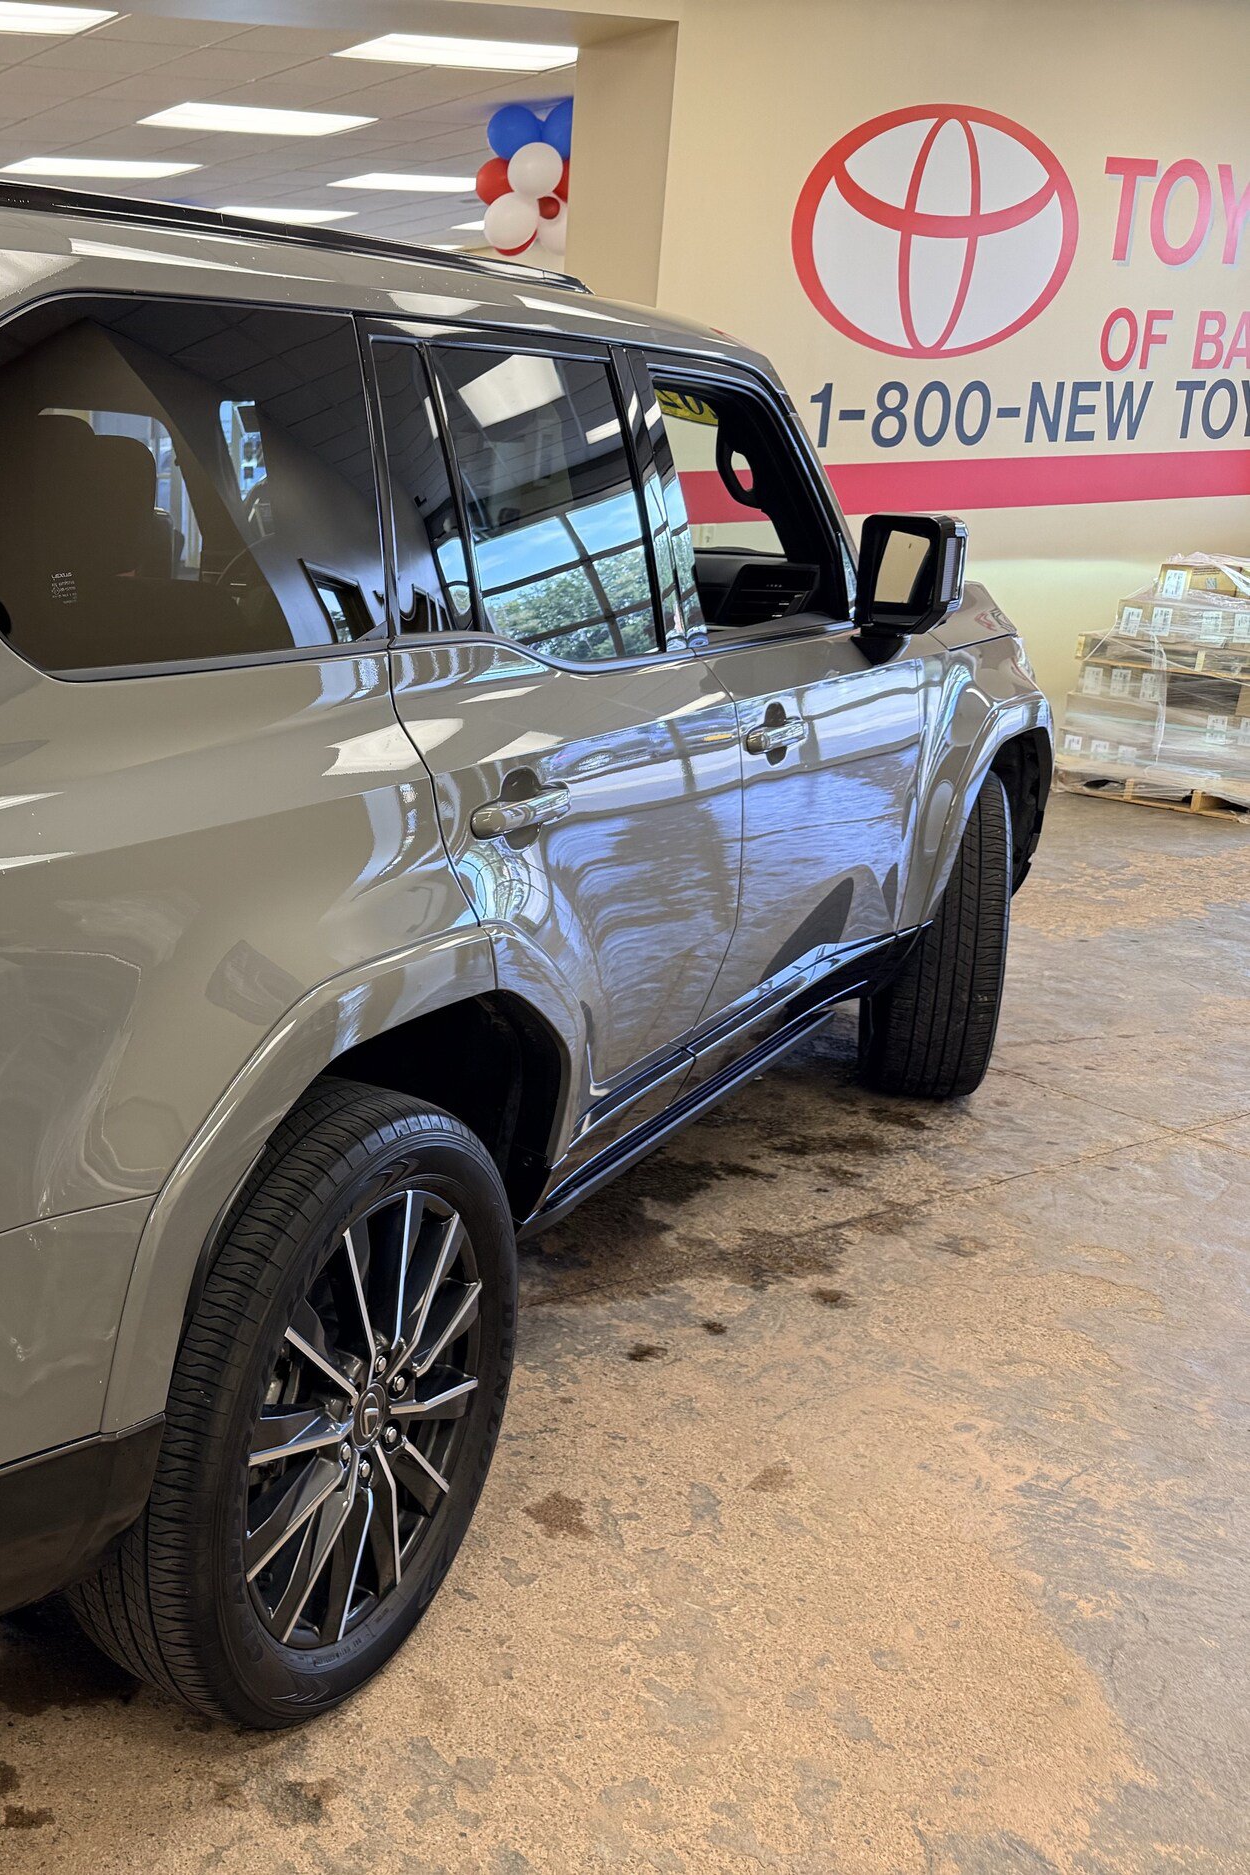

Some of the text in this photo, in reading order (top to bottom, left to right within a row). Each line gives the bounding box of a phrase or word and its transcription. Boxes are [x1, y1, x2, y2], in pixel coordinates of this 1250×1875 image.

[1100, 307, 1174, 372] OF
[809, 379, 1154, 449] 1-800-NEW
[467, 1297, 515, 1511] DUNLOP
